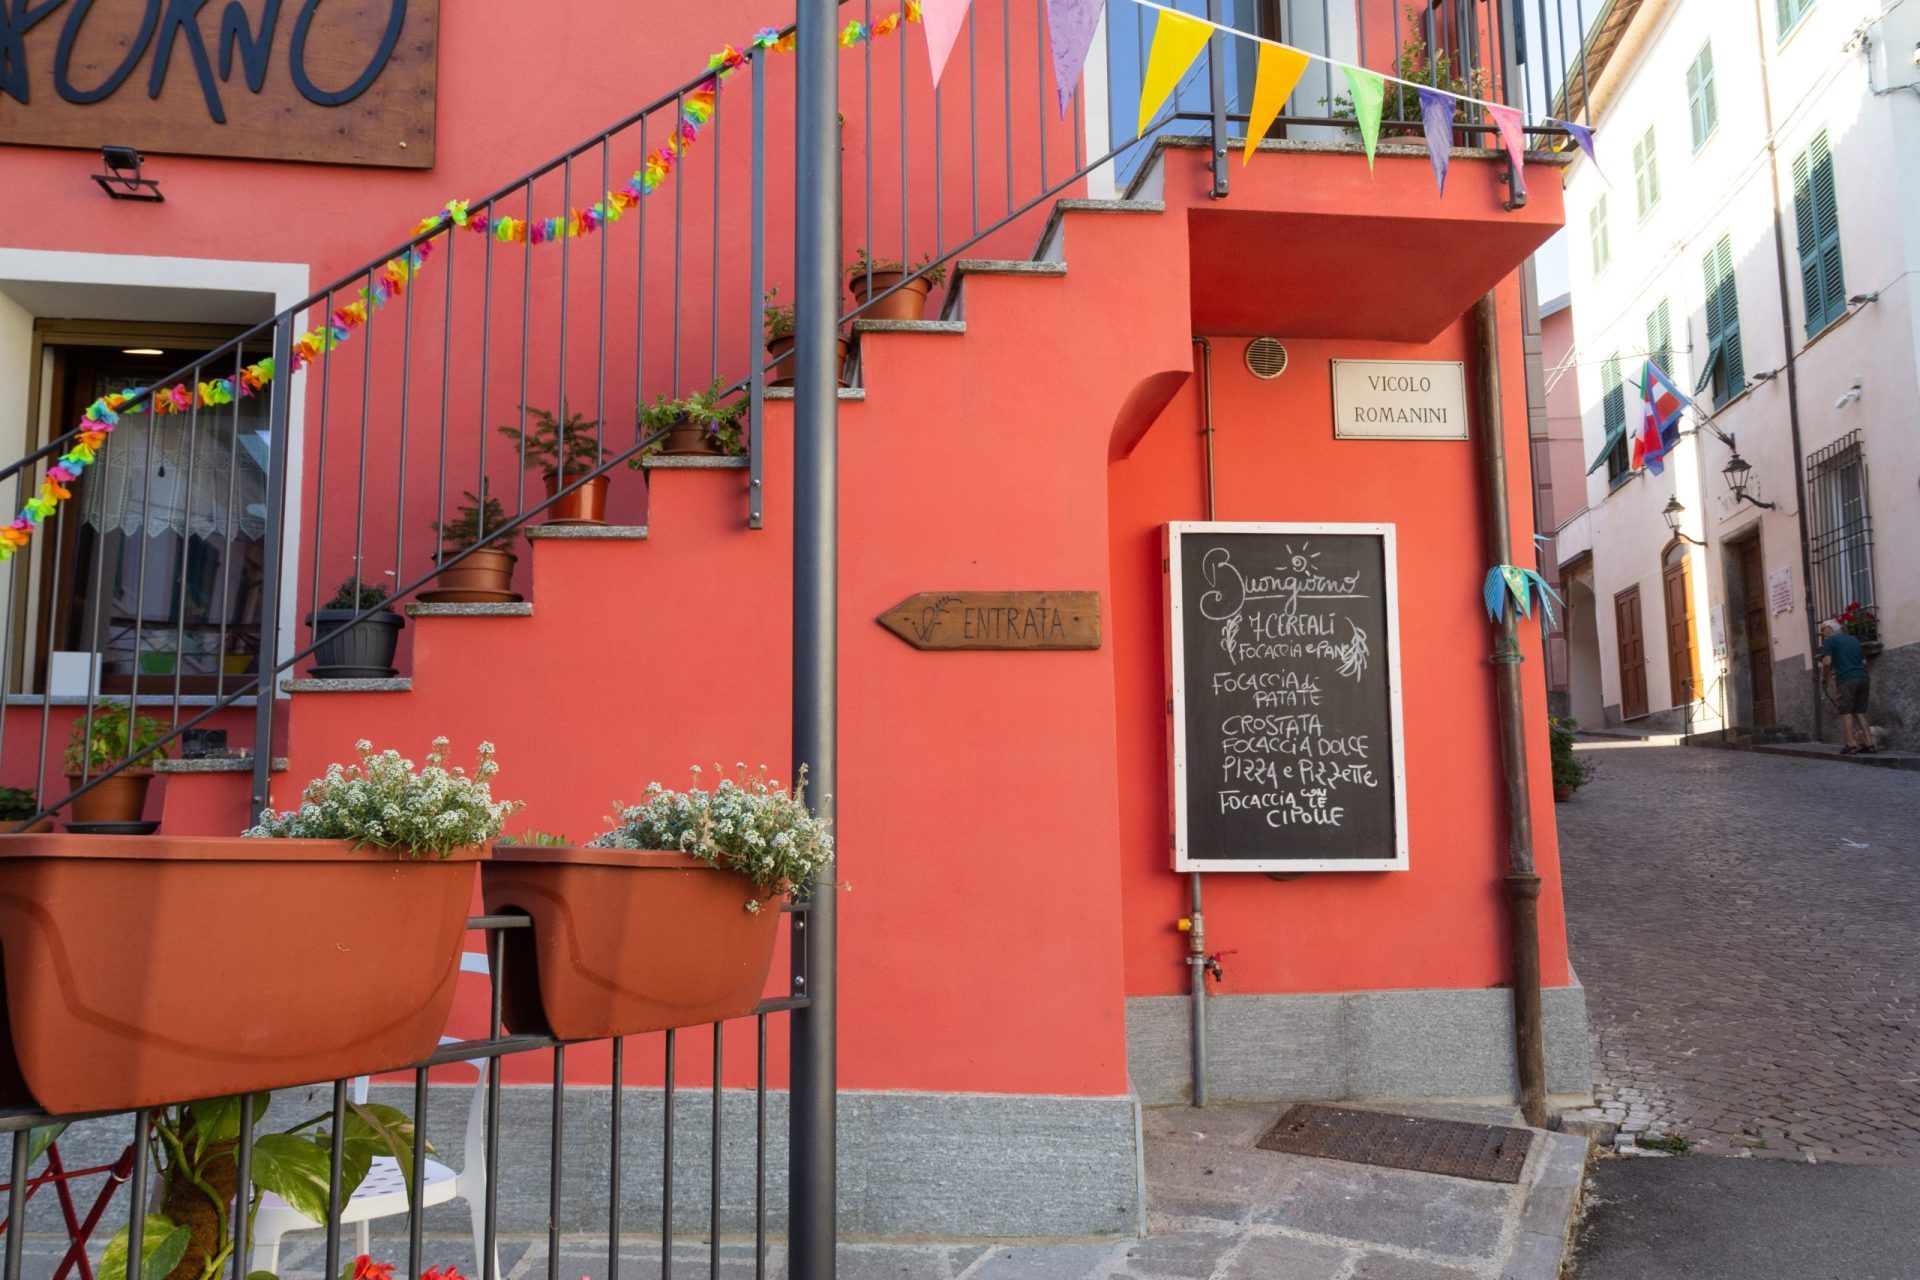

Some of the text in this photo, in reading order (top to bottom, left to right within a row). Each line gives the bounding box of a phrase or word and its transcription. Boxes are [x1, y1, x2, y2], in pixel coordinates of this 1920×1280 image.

[0, 0, 407, 124] ORNO
[1368, 375, 1431, 392] VICOLO
[1354, 406, 1448, 424] ROMANINI
[1200, 547, 1360, 621] Buongiorno
[963, 607, 1066, 640] ENTRATA
[1249, 611, 1265, 642] 7
[1301, 674, 1321, 690] di
[1253, 689, 1323, 709] PATATE
[1221, 714, 1325, 738] CROSTATA
[1318, 735, 1369, 758] DOLCE
[1222, 755, 1278, 789] PIZZA
[1309, 797, 1328, 808] LE
[1266, 806, 1345, 828] CIPOLLE
